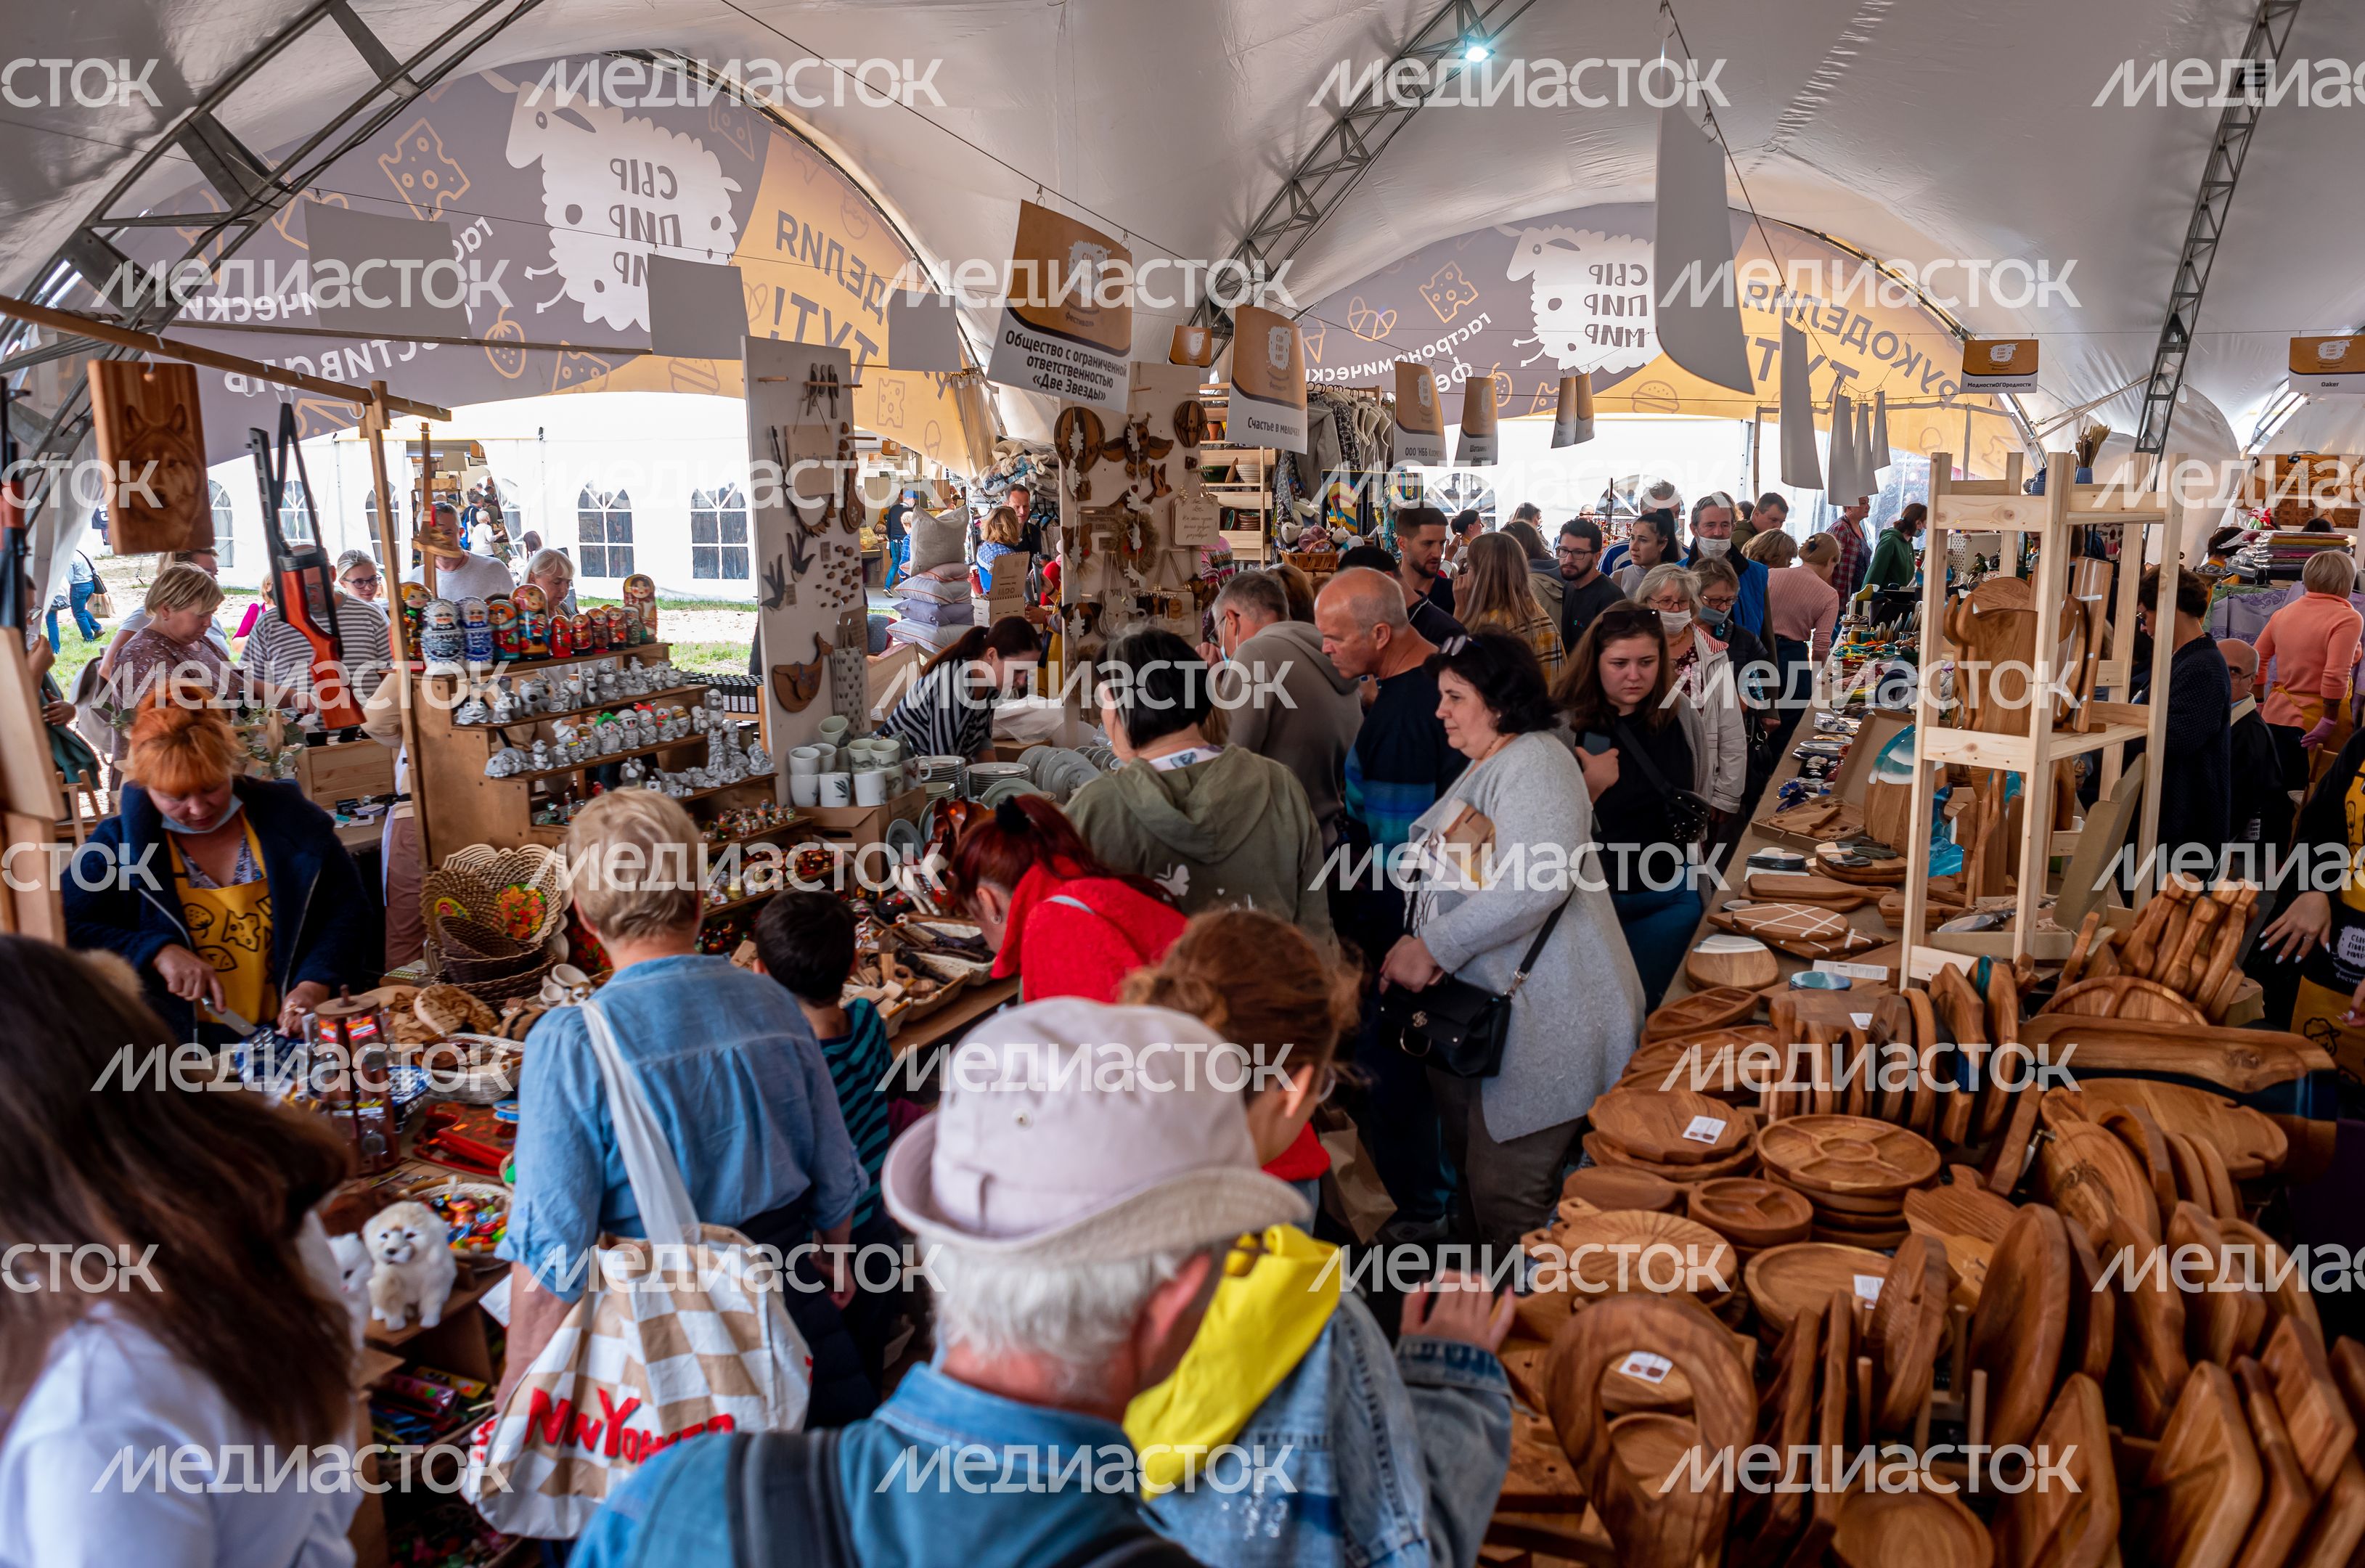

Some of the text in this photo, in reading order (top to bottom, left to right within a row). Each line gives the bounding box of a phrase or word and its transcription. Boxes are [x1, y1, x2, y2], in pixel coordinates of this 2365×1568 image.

[1005, 330, 1127, 377] Общество с ограниченной
[1026, 356, 1114, 388] ответственностью
[1032, 373, 1106, 401] «Две Звезды»
[1248, 417, 1274, 431] Счастье
[1275, 423, 1279, 433] в
[1405, 446, 1416, 457] ООО
